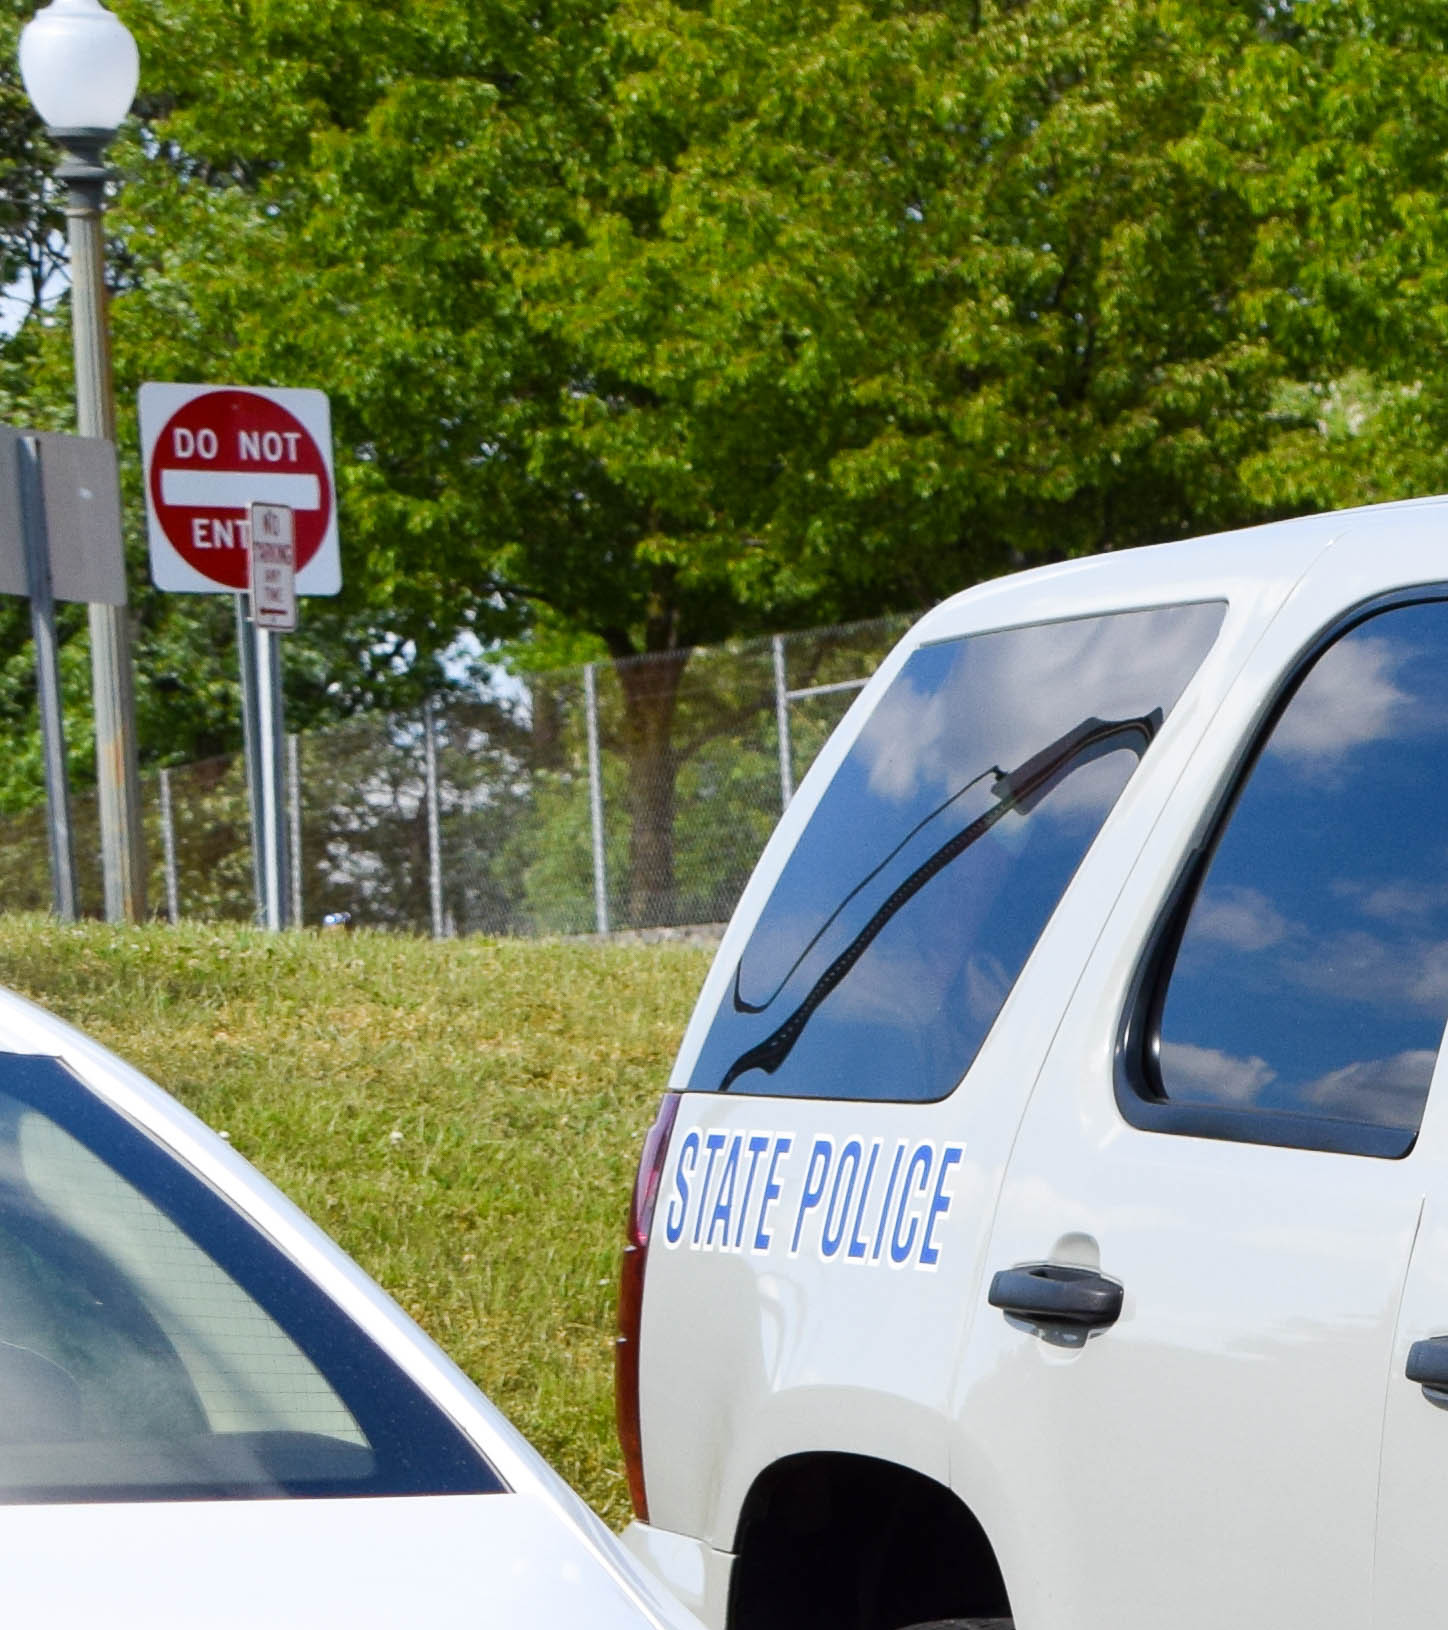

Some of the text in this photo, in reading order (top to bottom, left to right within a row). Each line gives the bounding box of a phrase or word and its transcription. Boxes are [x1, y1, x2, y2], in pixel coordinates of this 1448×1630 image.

[173, 427, 302, 463] DO NOT
[191, 518, 252, 550] ENT
[665, 1130, 964, 1265] STATE POLICE
